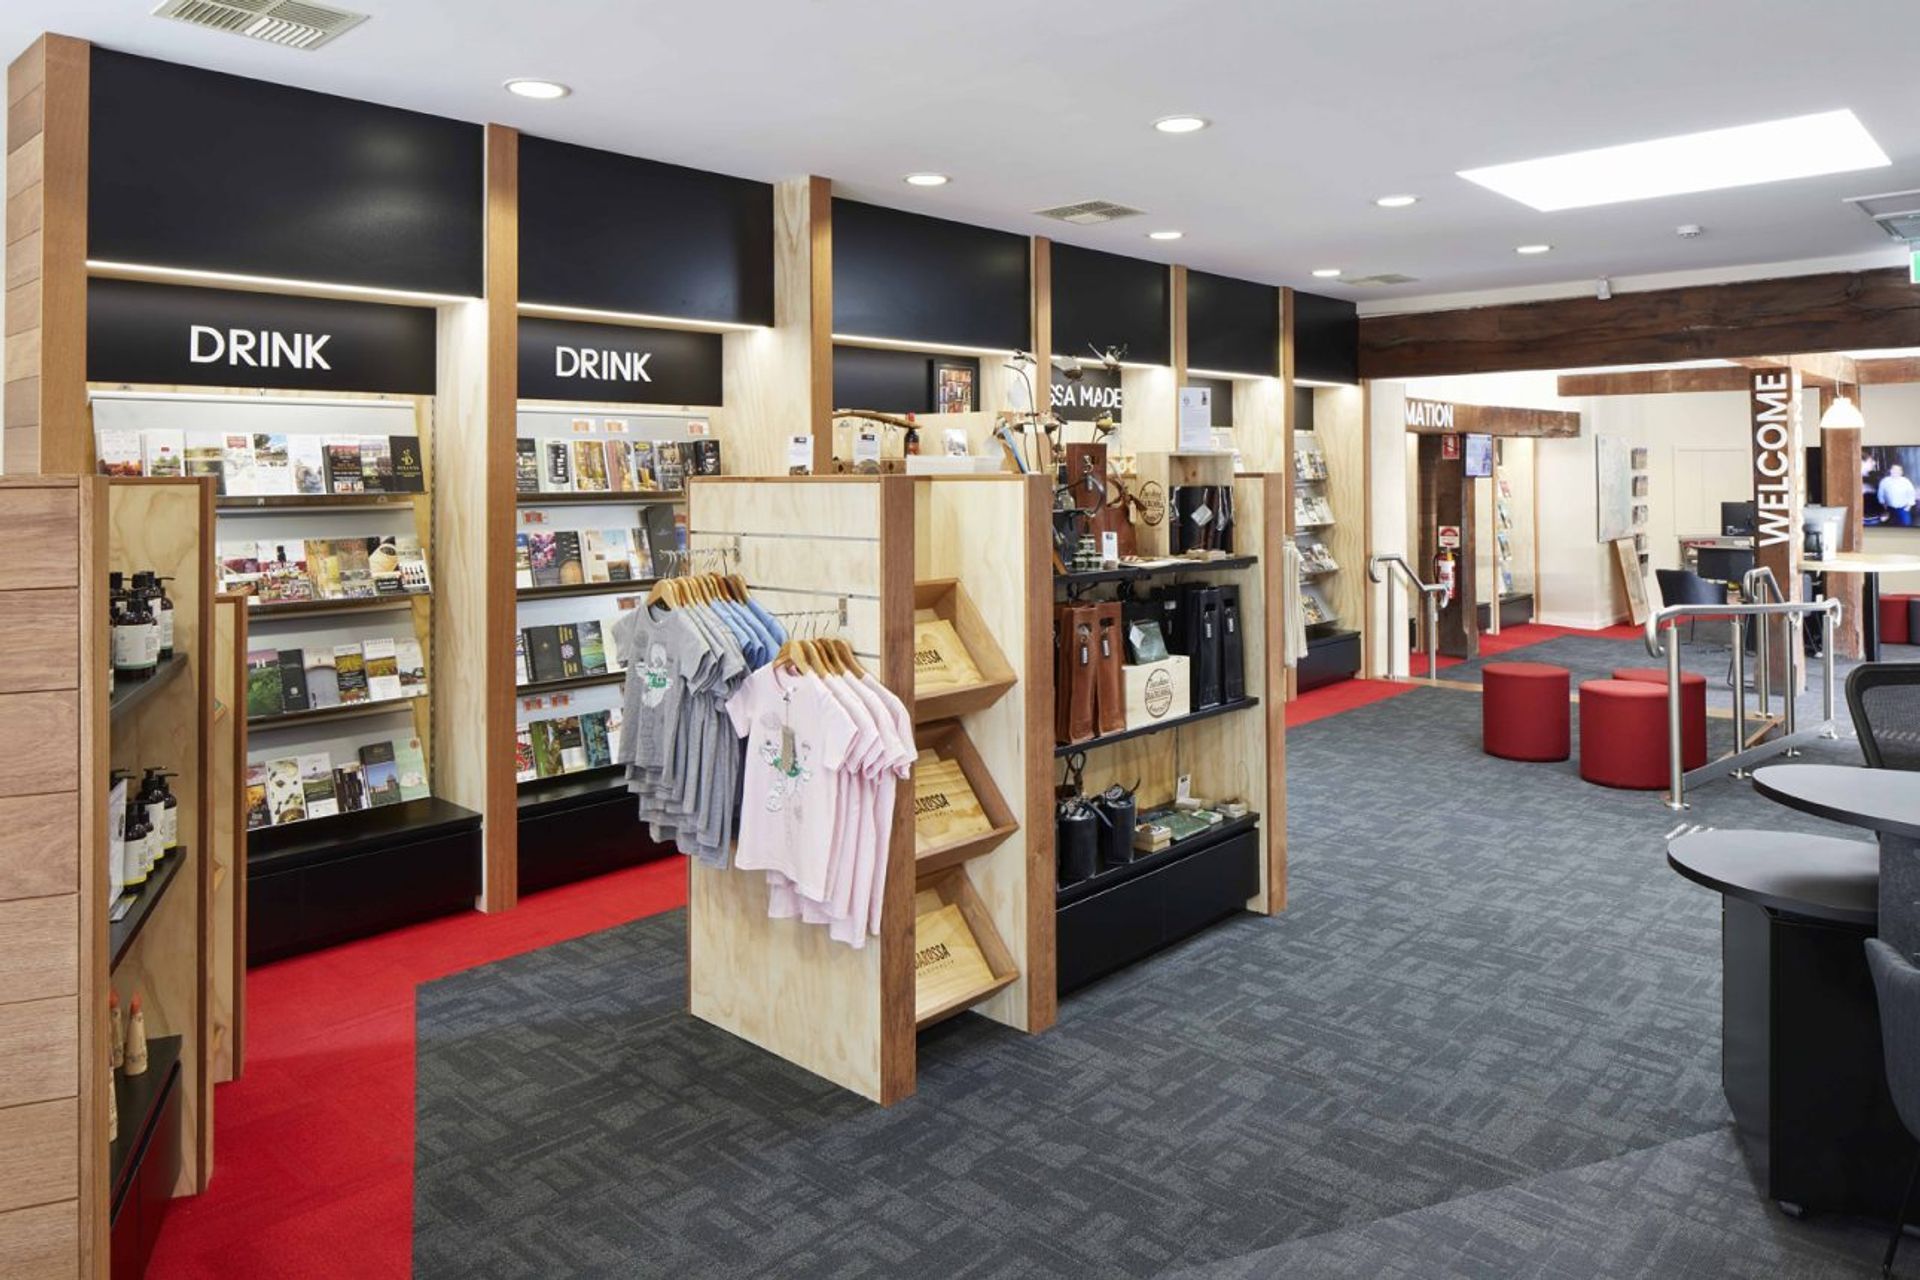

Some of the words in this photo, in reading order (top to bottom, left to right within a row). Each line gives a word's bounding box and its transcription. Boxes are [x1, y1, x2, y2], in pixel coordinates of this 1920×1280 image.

[190, 325, 331, 370] DRINK
[556, 346, 652, 382] DRINK
[1080, 385, 1123, 408] MADE
[1405, 401, 1454, 428] MATION
[1755, 373, 1791, 547] WELCOME
